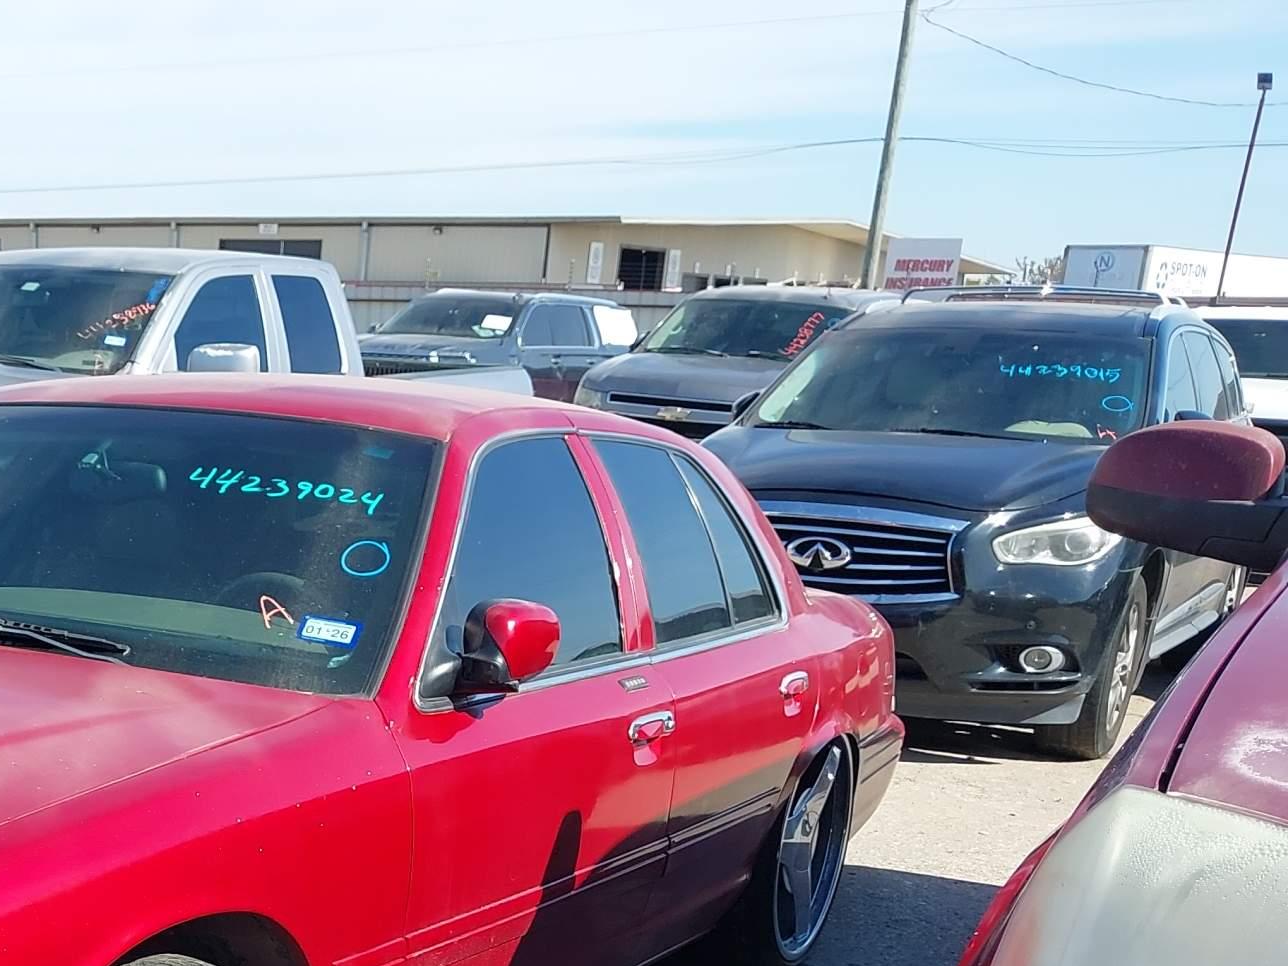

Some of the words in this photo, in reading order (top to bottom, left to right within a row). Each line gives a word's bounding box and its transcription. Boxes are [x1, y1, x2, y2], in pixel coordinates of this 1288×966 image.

[894, 258, 954, 272] MERCURY
[1169, 261, 1208, 280] SPOT-ON
[189, 467, 385, 515] 44239024
[260, 595, 295, 629] A
